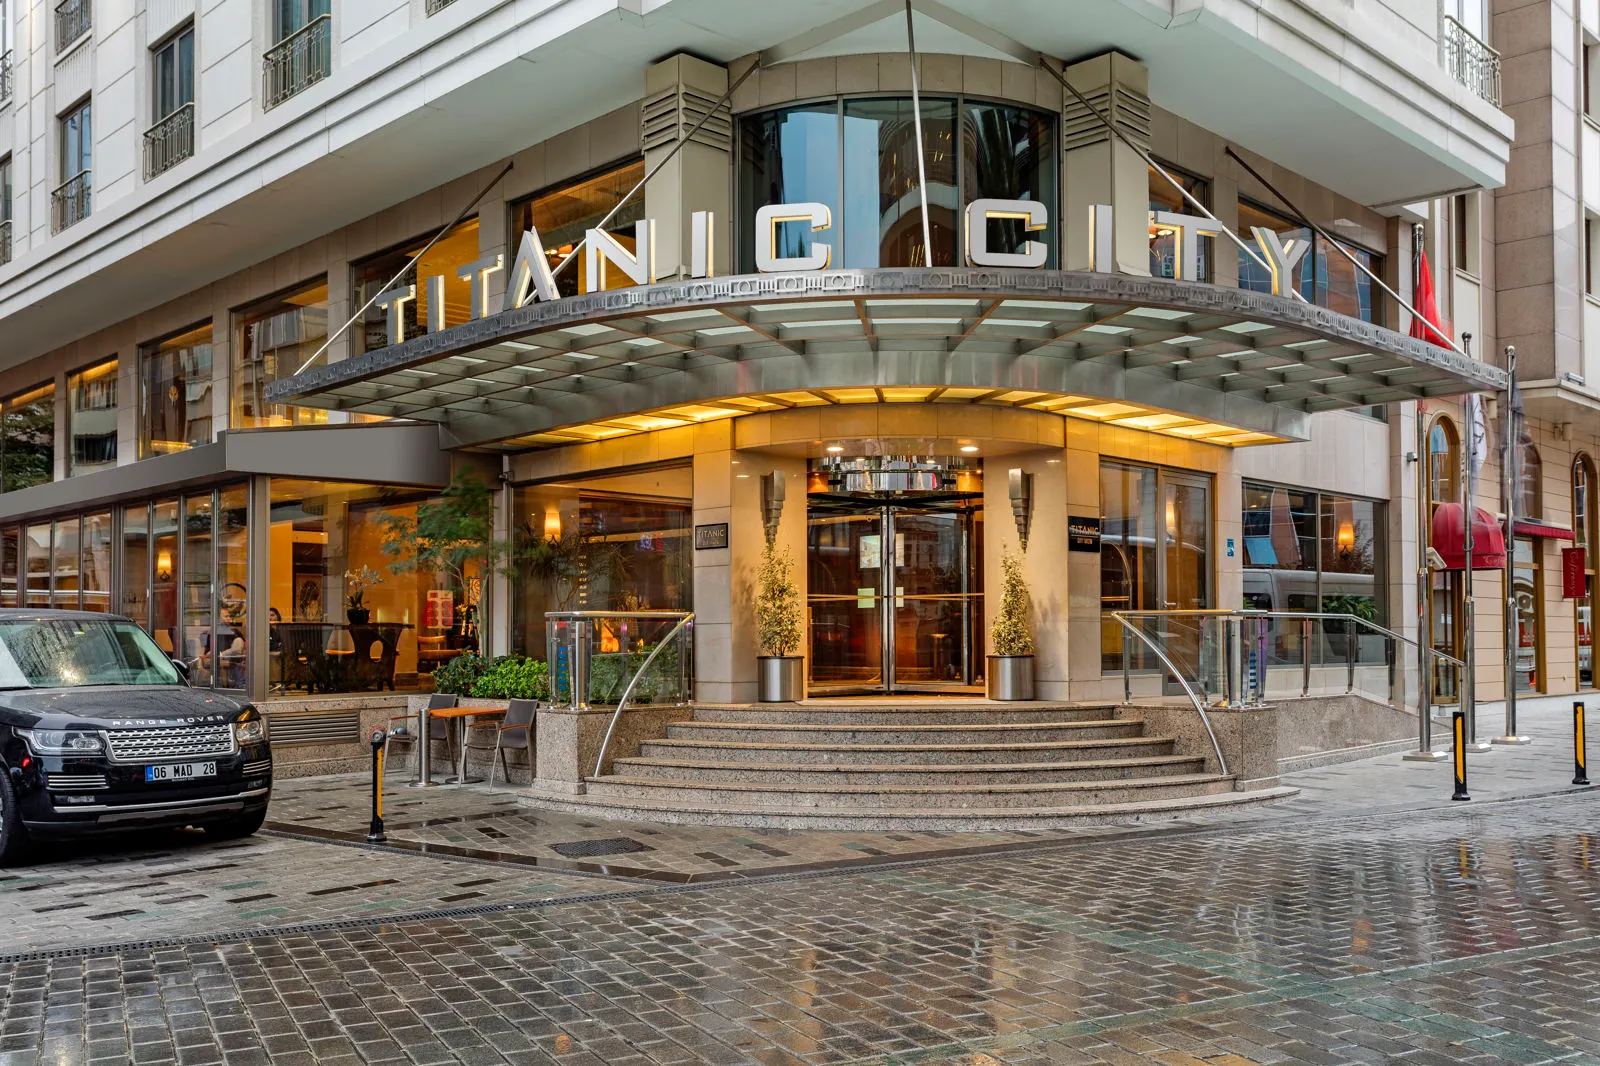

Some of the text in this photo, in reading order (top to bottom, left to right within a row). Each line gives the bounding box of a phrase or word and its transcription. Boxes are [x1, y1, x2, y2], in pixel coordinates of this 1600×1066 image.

[376, 198, 1310, 345] TITANIC CITY
[698, 530, 724, 538] TITANIC
[1071, 525, 1098, 535] TITANIC
[176, 715, 224, 723] ROVER
[154, 763, 215, 779] 06 MAD 28
